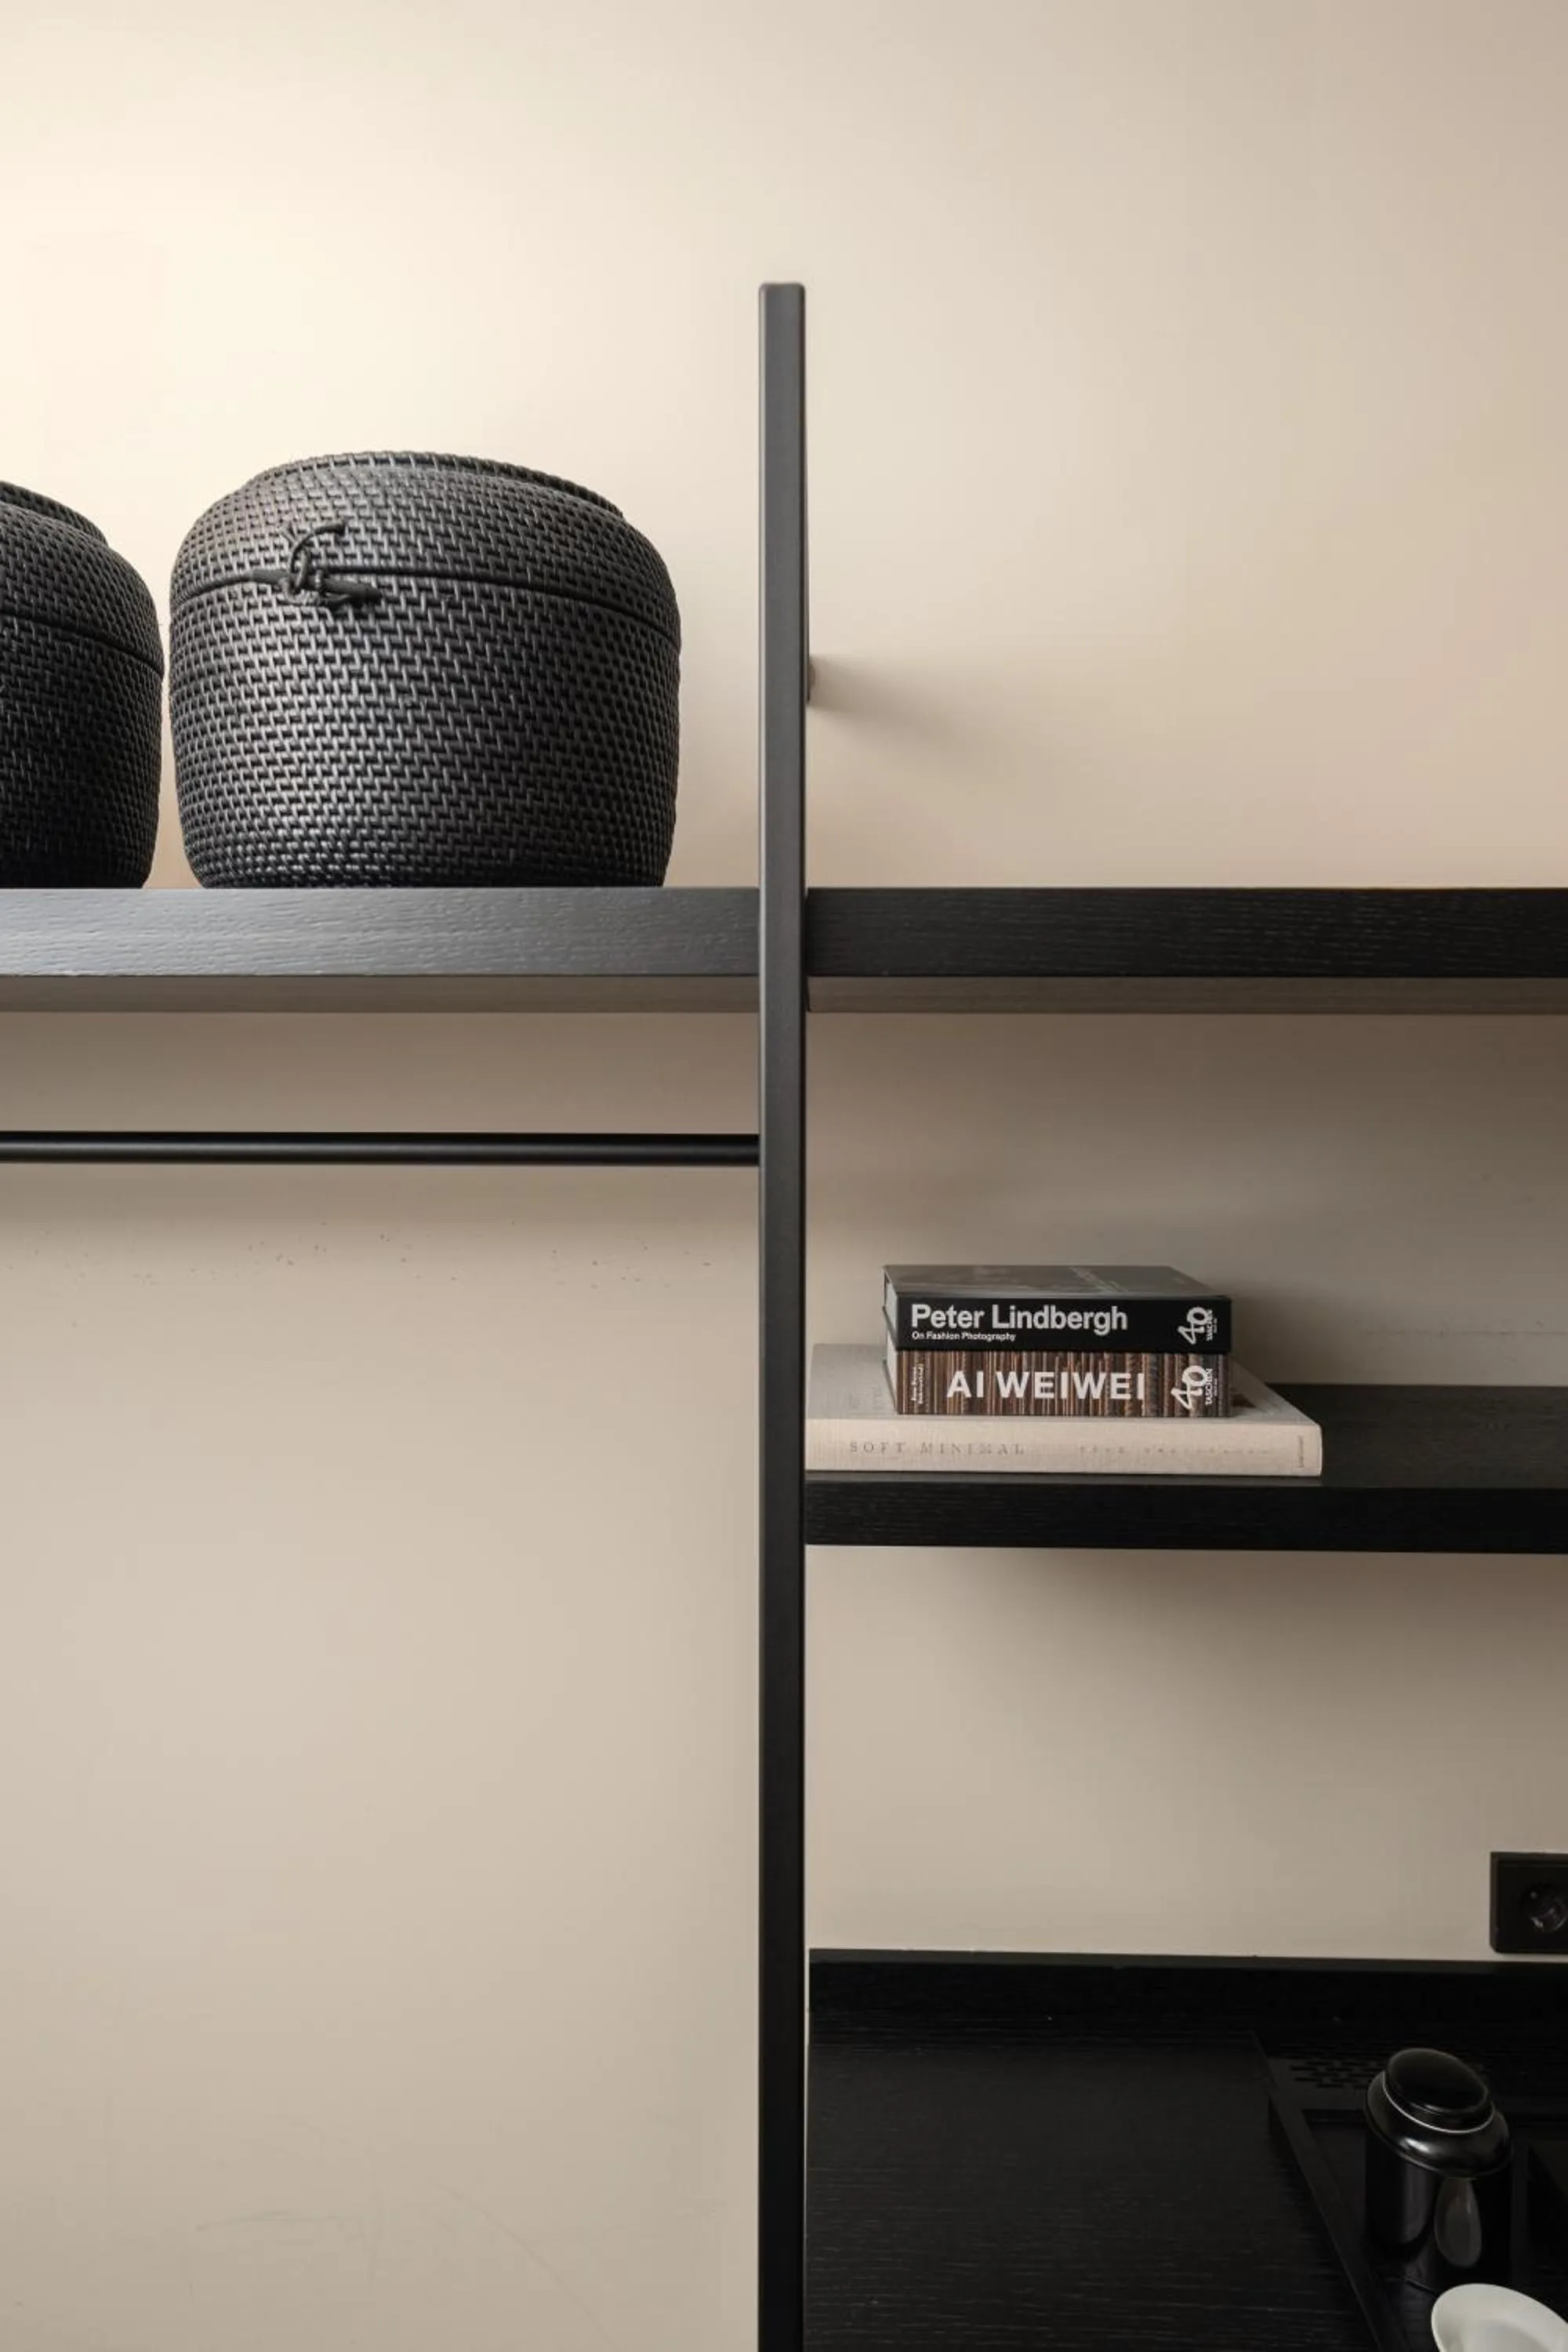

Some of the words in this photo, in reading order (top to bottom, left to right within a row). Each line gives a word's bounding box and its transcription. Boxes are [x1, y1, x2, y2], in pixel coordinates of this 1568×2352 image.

[911, 1304, 985, 1330] Peter
[992, 1304, 1128, 1336] Lindbergh
[911, 1330, 924, 1340] On
[926, 1331, 960, 1340] Fashion
[961, 1332, 1017, 1342] Photography
[946, 1370, 984, 1398] AI
[996, 1371, 1145, 1399] WEIWEI
[850, 1442, 906, 1454] SOFT
[920, 1442, 1026, 1456] MINIMAL
